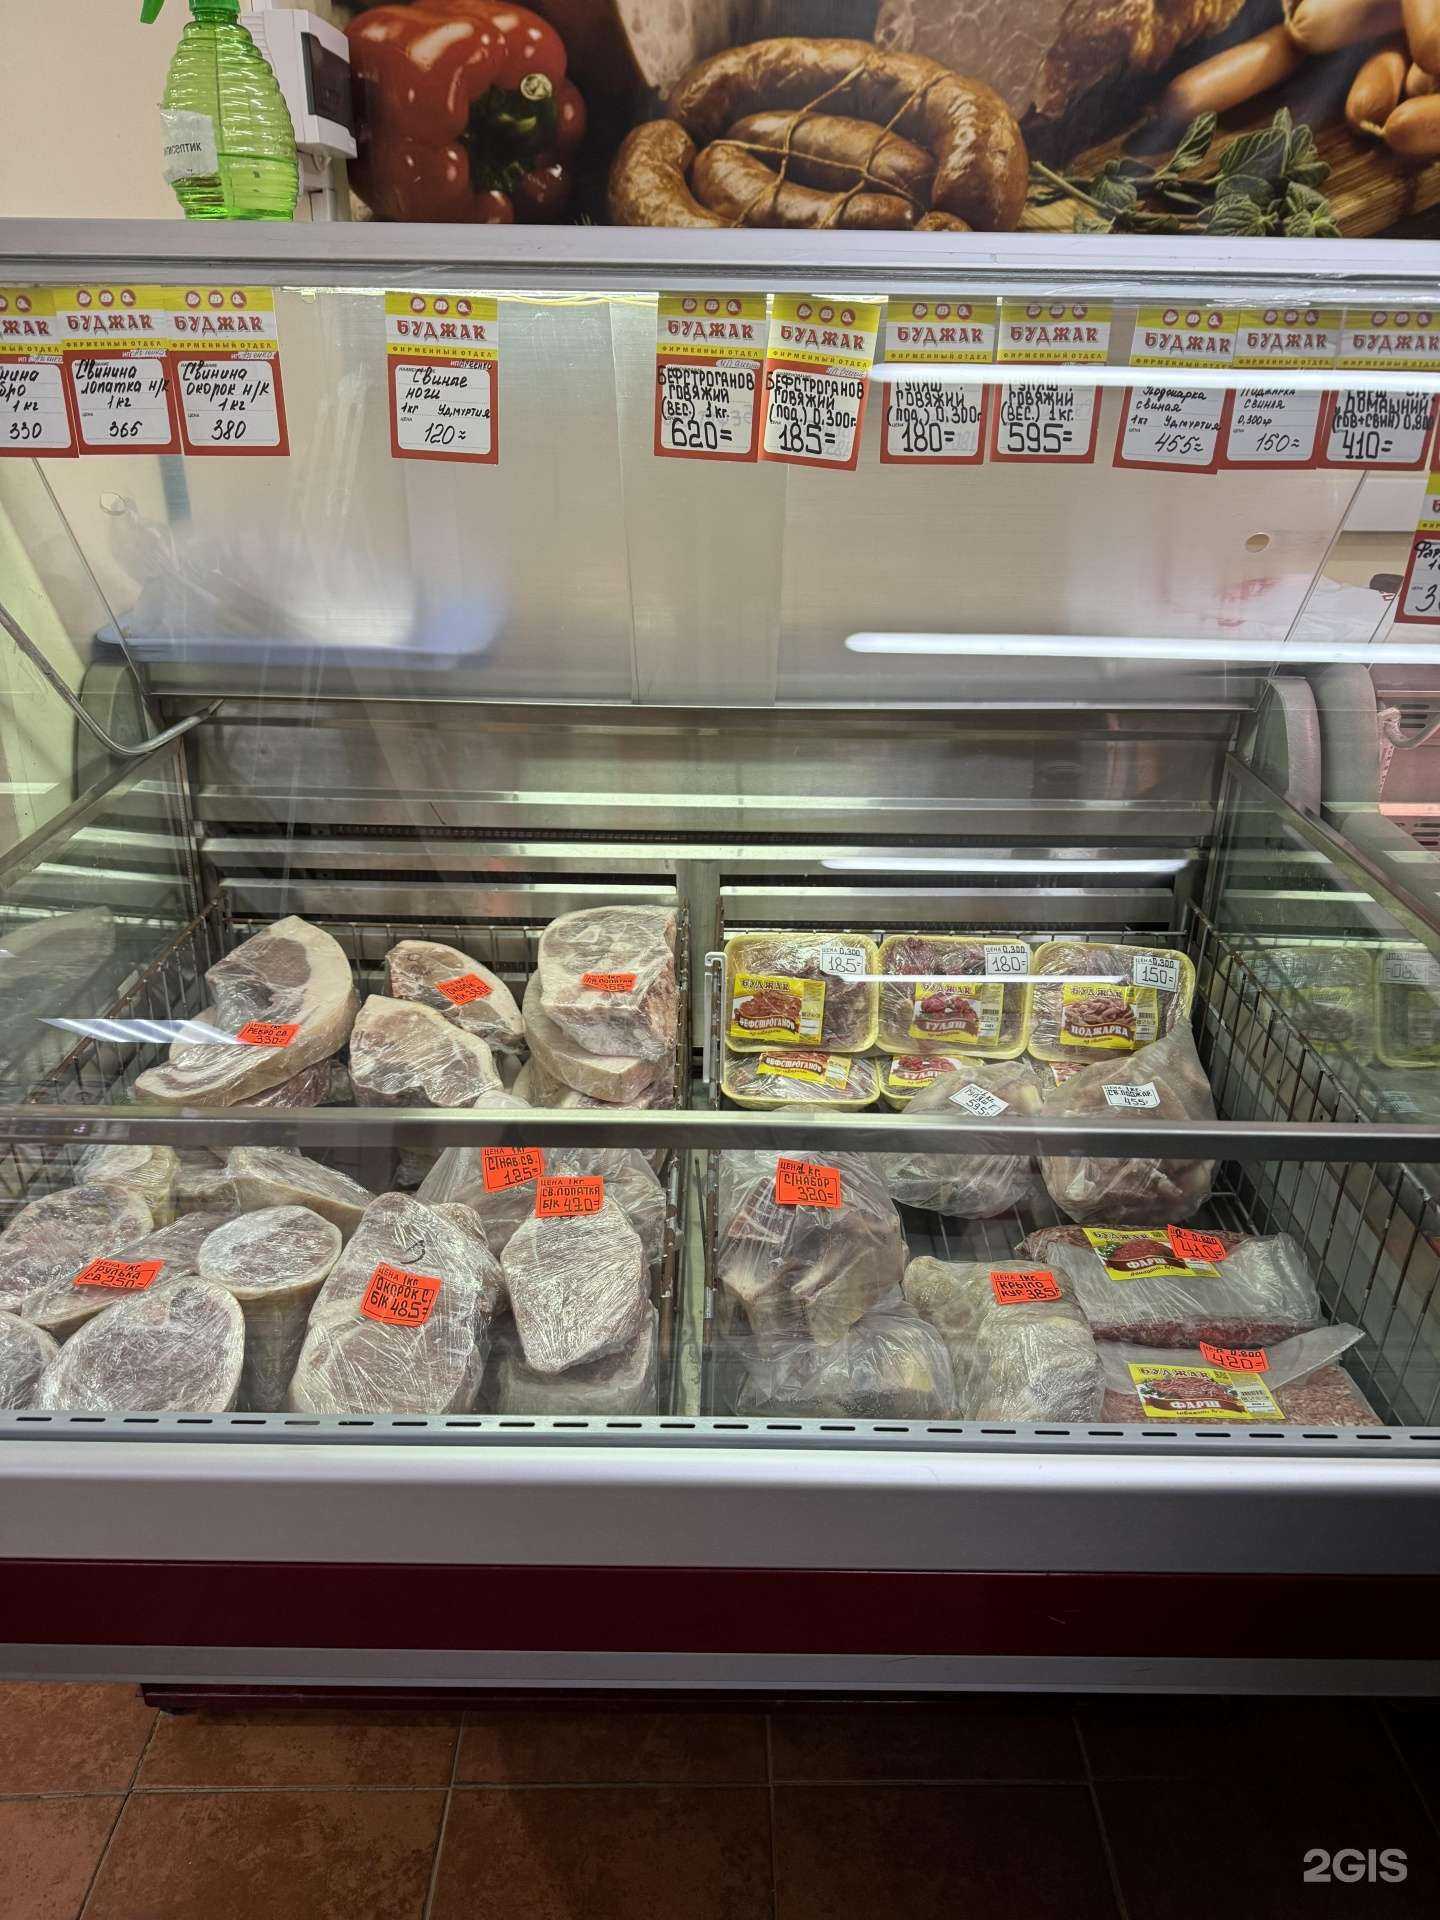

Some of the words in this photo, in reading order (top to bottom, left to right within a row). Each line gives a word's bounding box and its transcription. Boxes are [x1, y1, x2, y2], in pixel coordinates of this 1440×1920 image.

[0, 319, 49, 336] ЖАК
[66, 314, 153, 335] БУДЖАК
[174, 316, 263, 336] БУДЖАК
[397, 320, 486, 341] БУДЖАК
[668, 320, 754, 341] БУДЖАК
[781, 325, 864, 351] БУДЖАК
[897, 327, 983, 347] БУДЖАК
[1010, 326, 1098, 346] БУДЖАК
[1145, 332, 1231, 355] БУДЖАК
[1247, 333, 1327, 353] БУДЖАК
[0, 383, 26, 402] бро
[10, 422, 42, 440] 330
[110, 421, 142, 437] 365
[212, 420, 246, 440] 380
[1415, 541, 1440, 558] Фар
[1415, 584, 1440, 611] 3
[1071, 1025, 1128, 1037] ПОДЖАРКА
[1126, 1258, 1167, 1269] ФАРШ
[1171, 1401, 1221, 1410] ФАРШ
